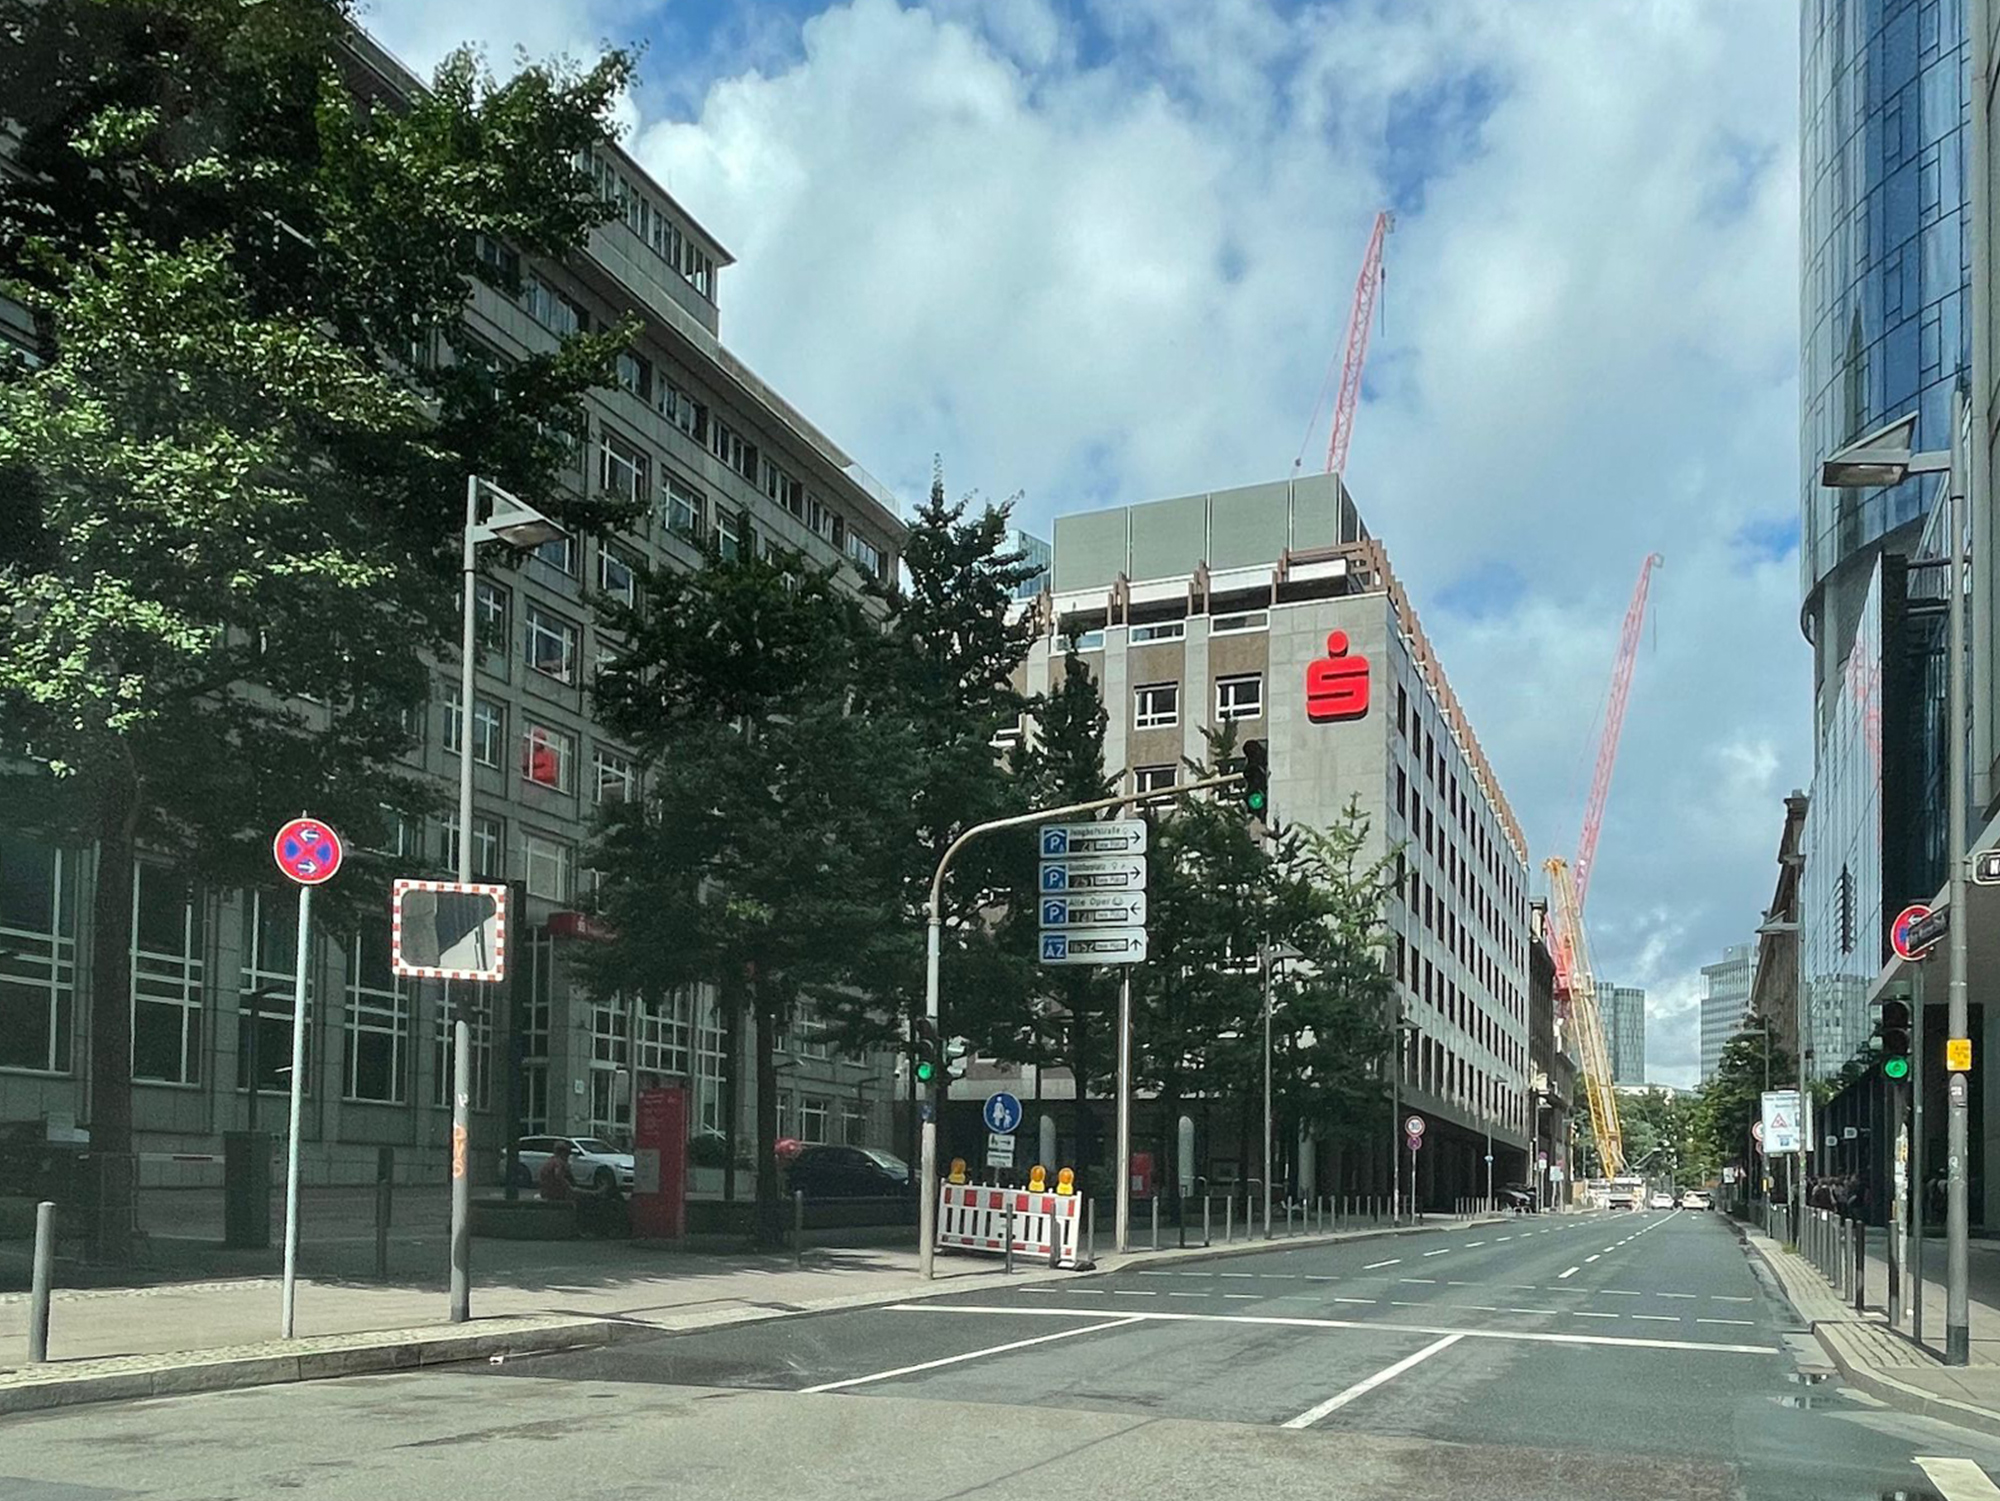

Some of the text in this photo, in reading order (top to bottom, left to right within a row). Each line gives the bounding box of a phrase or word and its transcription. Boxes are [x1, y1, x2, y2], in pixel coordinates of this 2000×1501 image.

[1050, 836, 1060, 850] P
[1990, 859, 2000, 875] N
[1049, 872, 1059, 886] P
[1049, 907, 1059, 920] P
